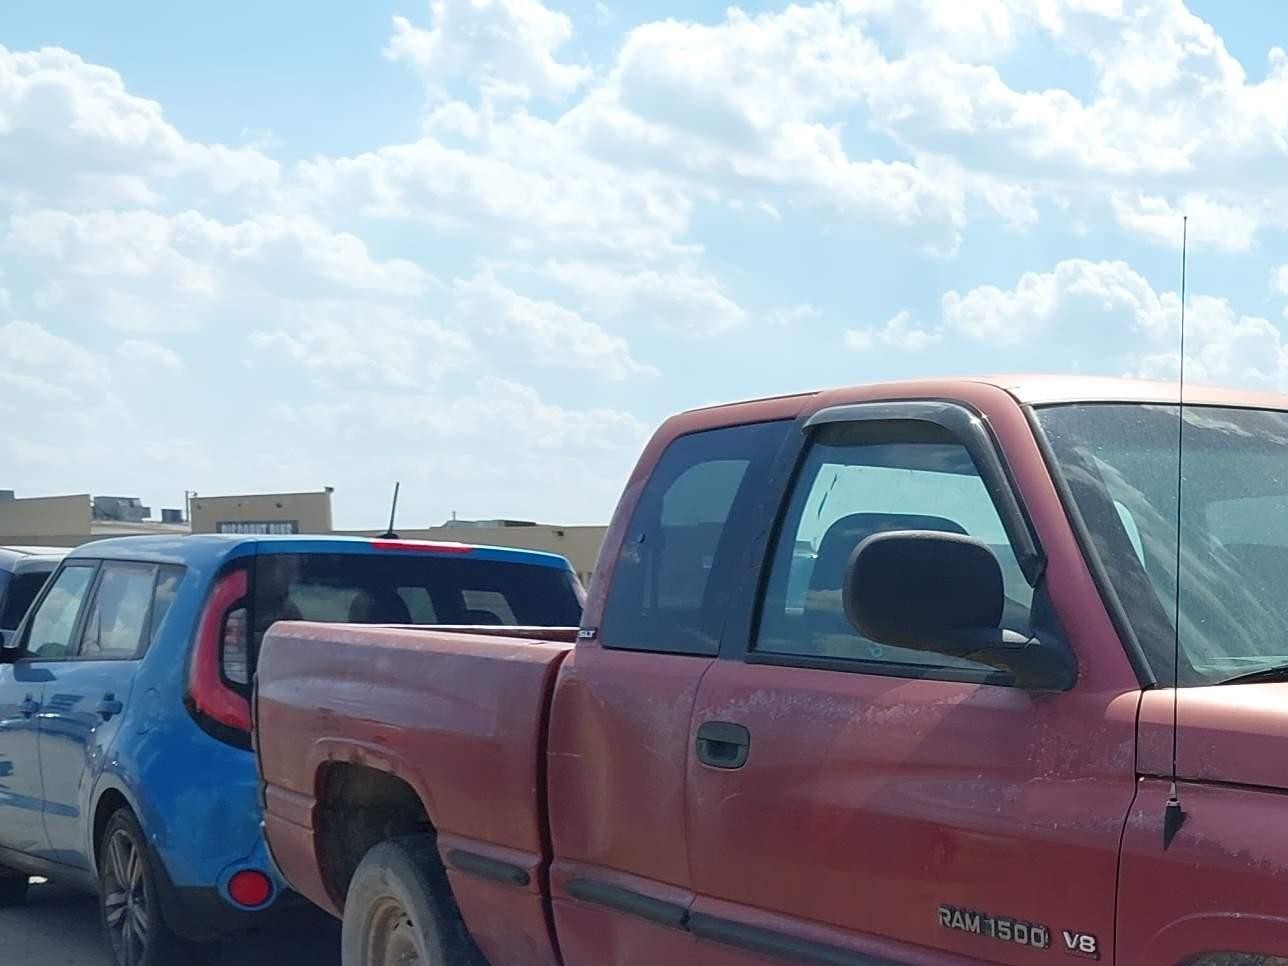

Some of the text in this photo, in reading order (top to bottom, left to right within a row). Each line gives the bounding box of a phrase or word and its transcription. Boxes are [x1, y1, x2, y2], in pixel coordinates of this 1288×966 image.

[938, 905, 1047, 949] RAM 1500
[1063, 930, 1097, 953] V8
